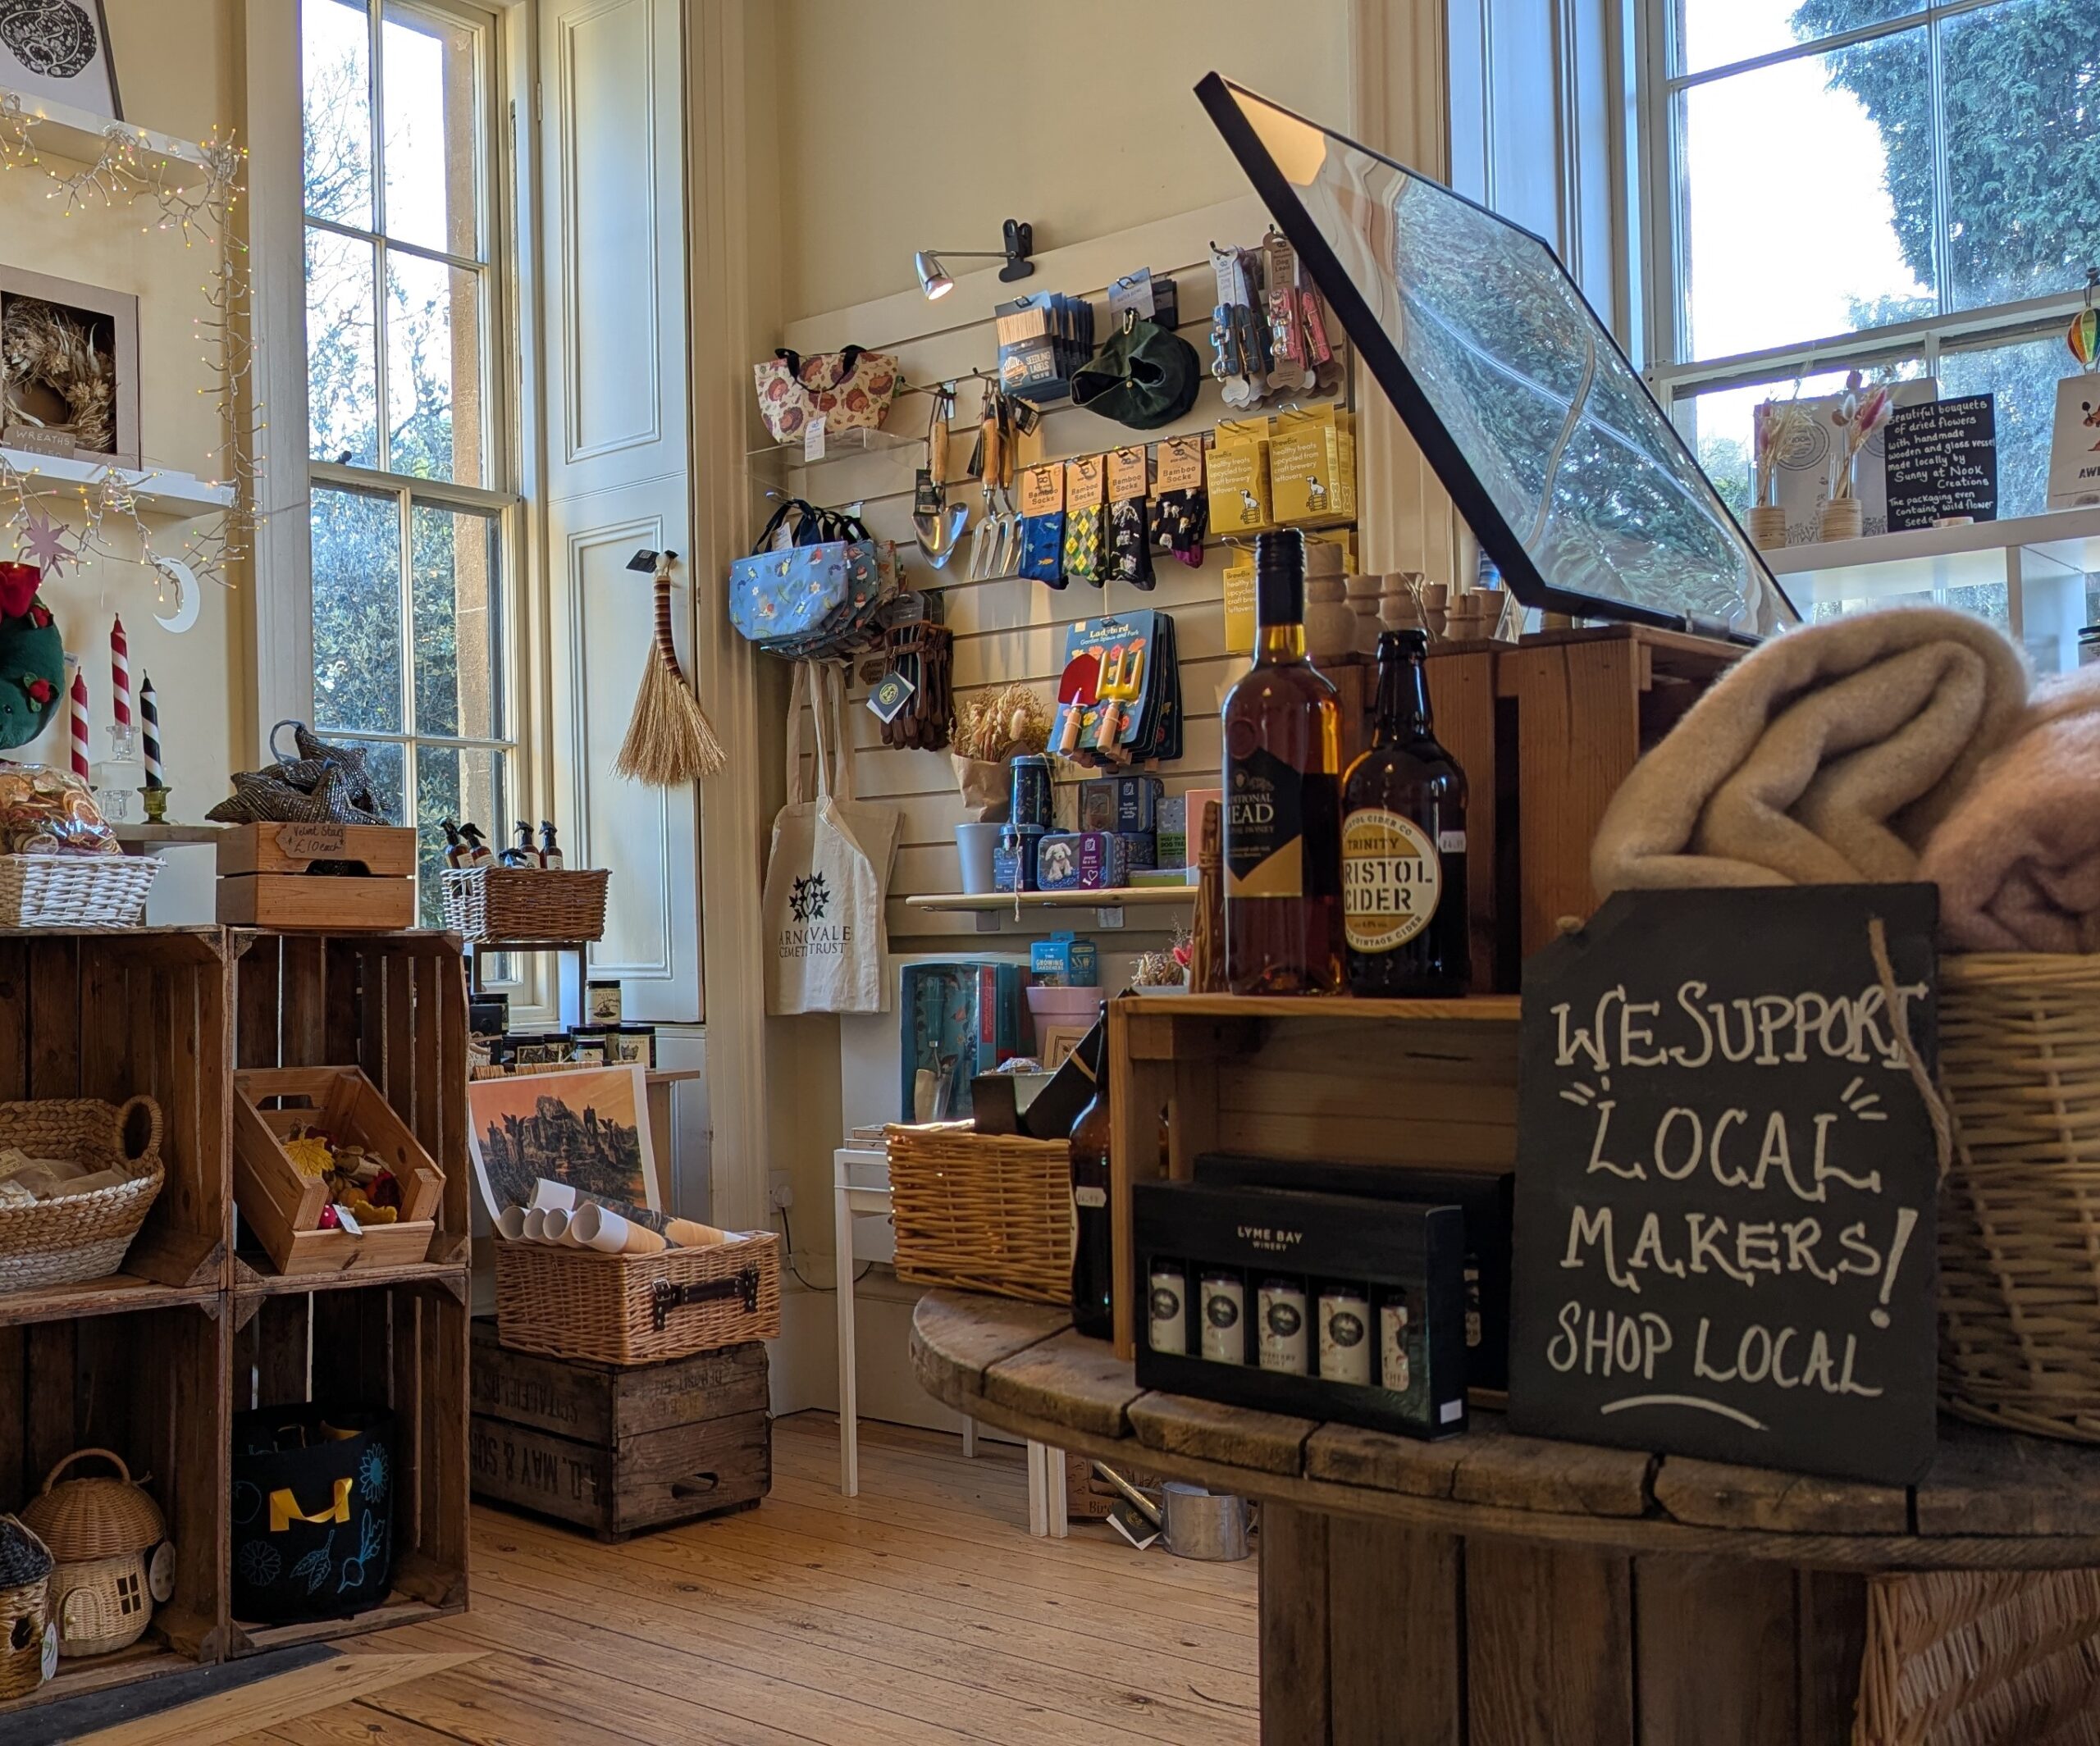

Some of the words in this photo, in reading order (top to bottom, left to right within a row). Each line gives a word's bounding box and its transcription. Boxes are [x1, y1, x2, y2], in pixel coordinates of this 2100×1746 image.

[1026, 351, 1051, 365] SEEDLING
[1029, 361, 1050, 373] LABELS
[1938, 399, 1988, 415] bouquets
[1894, 423, 1907, 435] of
[1909, 419, 1936, 432] dried
[1938, 416, 1977, 428] flowers
[16, 430, 71, 446] WREATHS
[1888, 437, 1911, 450] with
[1914, 429, 1965, 444] handmade
[1297, 442, 1317, 452] treats
[1304, 450, 1320, 459] from
[1888, 448, 1921, 460] wooden
[1924, 443, 1942, 454] and
[1944, 440, 1970, 454] glass
[1888, 460, 1911, 472] made
[1915, 455, 1948, 467] locally
[1953, 454, 1966, 464] by
[1162, 466, 1197, 477] Bamboo
[1166, 474, 1193, 483] Socks
[1894, 471, 1929, 482] Sunny
[1933, 467, 1946, 477] at
[1112, 475, 1143, 486] Bamboo
[1116, 483, 1139, 493] Socks
[1937, 476, 1989, 489] Creations
[1028, 488, 1059, 499] Bamboo
[1071, 483, 1099, 496] Bamboo
[1074, 491, 1095, 502] Socks
[1031, 495, 1055, 505] Socks
[1888, 497, 1905, 507] The
[1906, 491, 1953, 506] packaging
[1942, 500, 1964, 512] wild
[1965, 498, 1994, 509] flower
[1089, 623, 1130, 638] Ladybird
[294, 824, 319, 837] Velvet
[294, 838, 320, 854] £10
[1348, 837, 1399, 850] TRINITY
[1345, 887, 1413, 911] CIDER
[810, 925, 851, 941] VALE
[1395, 915, 1422, 939] CIDER
[809, 942, 847, 955] TRUST
[1550, 984, 1668, 1071] WE
[1669, 981, 1928, 1069] SUPPORT
[1586, 1100, 1882, 1202] LOCAL
[1237, 1226, 1271, 1240] LYME
[1277, 1230, 1303, 1245] BAY
[1253, 1241, 1287, 1252] WINERY
[1560, 1205, 1919, 1328] MAKERS!
[1547, 1300, 1673, 1380] SHOP
[1695, 1316, 1883, 1396] LOCAL
[503, 1440, 515, 1488] &
[521, 1447, 559, 1494] MAY
